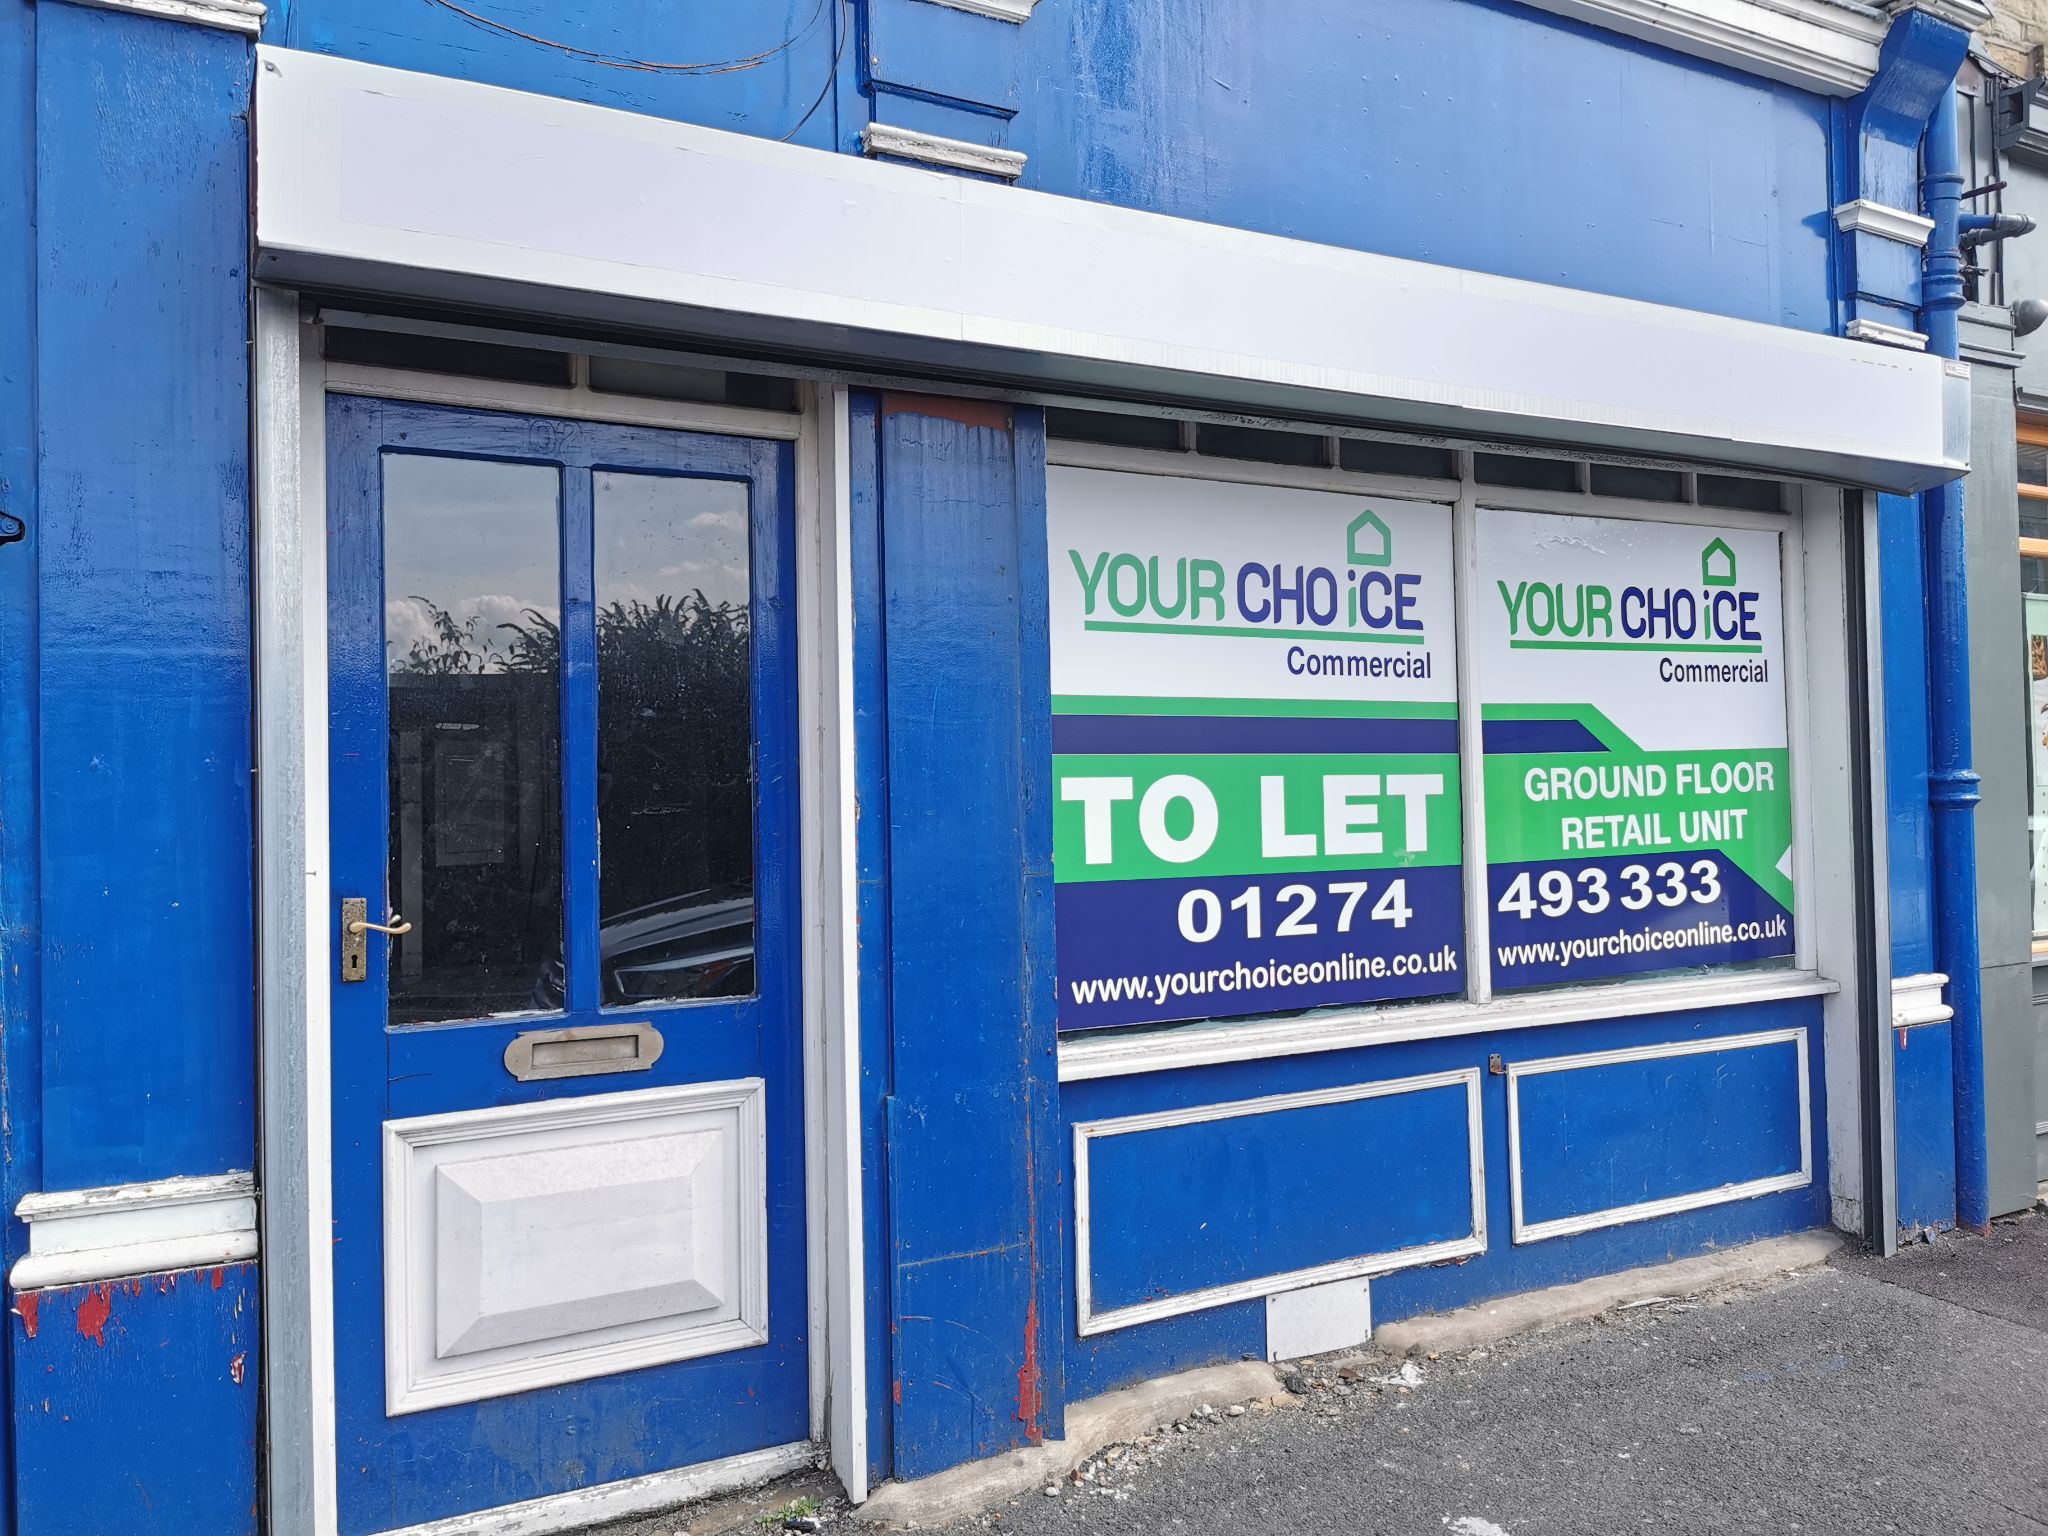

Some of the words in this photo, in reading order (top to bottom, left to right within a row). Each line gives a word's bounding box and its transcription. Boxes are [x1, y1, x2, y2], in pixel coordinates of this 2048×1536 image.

[1068, 549, 1225, 622] YOUR
[1497, 580, 1613, 638] YOUR
[1287, 645, 1431, 679] Commercial
[1659, 657, 1768, 683] Commercial
[1524, 765, 1667, 802] GROUND
[1676, 761, 1775, 795] FLOOR
[1061, 774, 1219, 865] TO
[1260, 773, 1444, 858] LET
[1561, 813, 1672, 851] RETAIL
[1679, 808, 1748, 844] UNIT
[1177, 878, 1413, 943] 01274
[1497, 867, 1610, 919] 493
[1620, 859, 1721, 910] 333
[1497, 914, 1787, 967] www.yourchoiceonline.co.uk
[1071, 945, 1457, 1005] www.yourchoiceonline.co.uk
